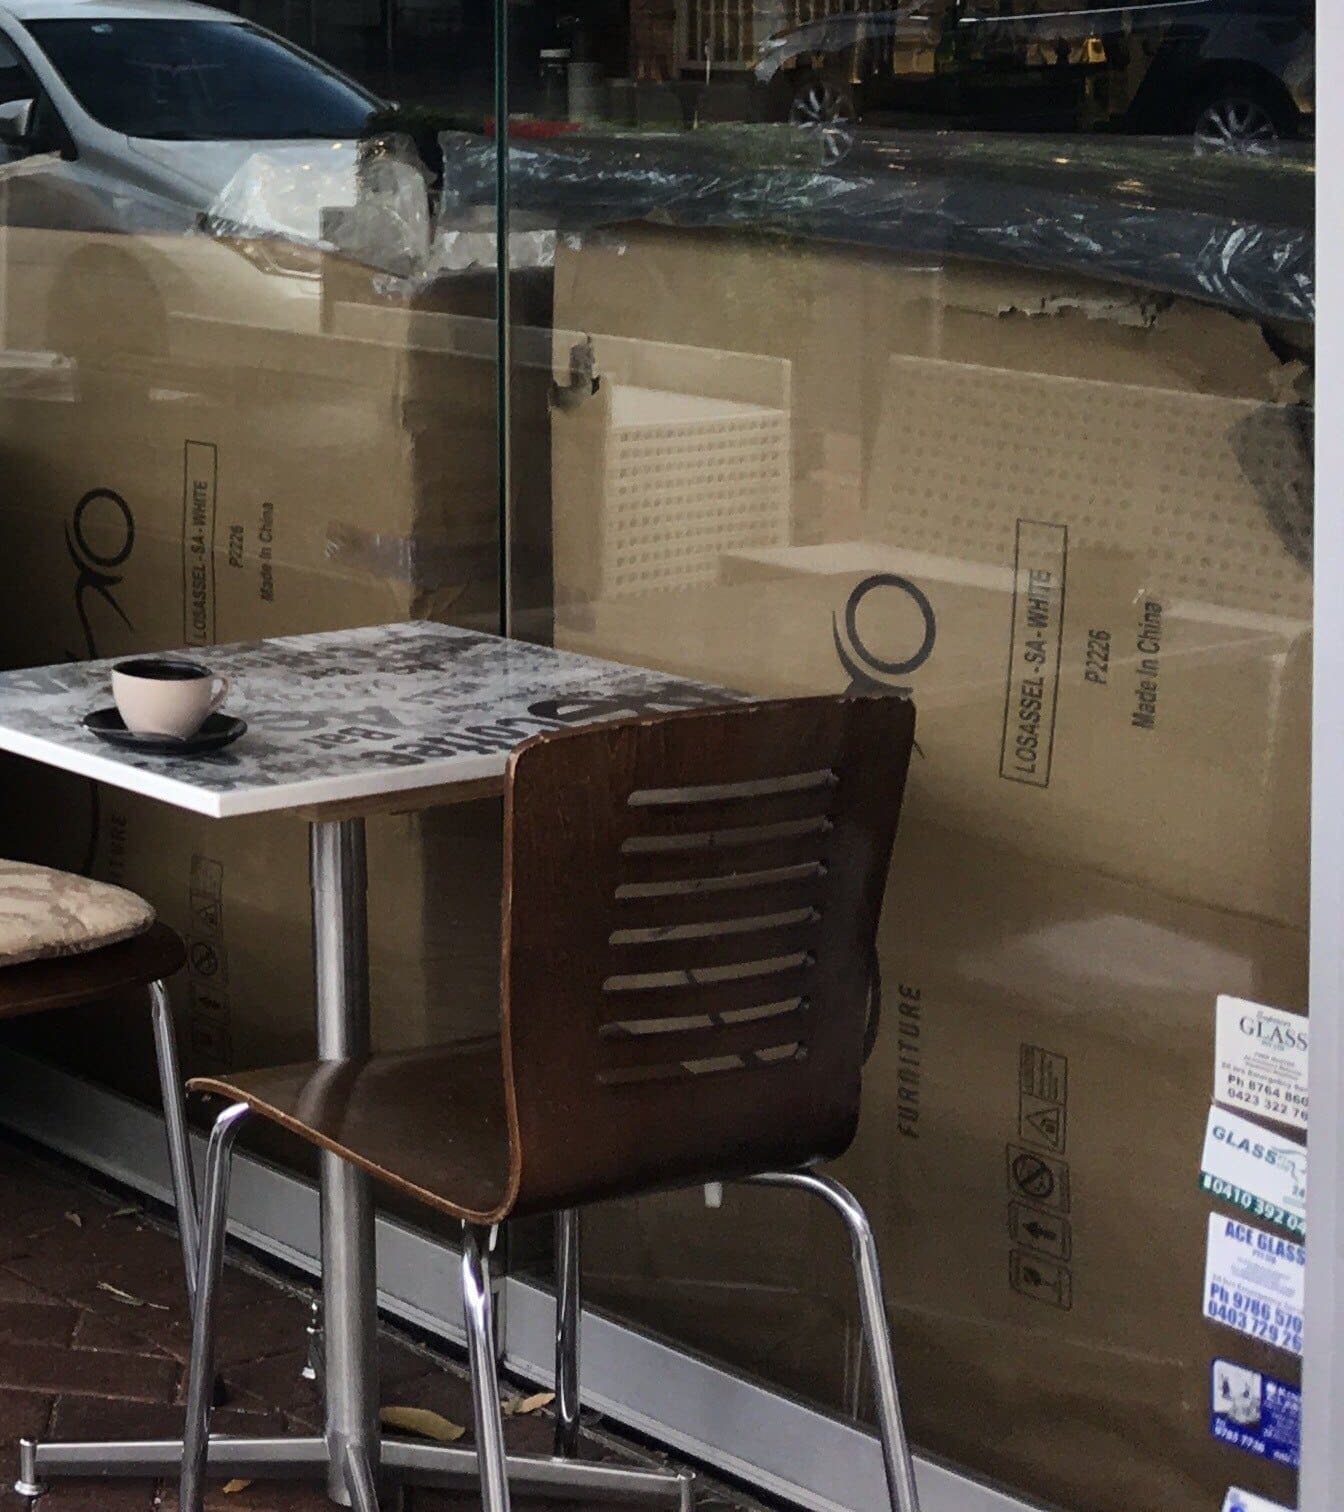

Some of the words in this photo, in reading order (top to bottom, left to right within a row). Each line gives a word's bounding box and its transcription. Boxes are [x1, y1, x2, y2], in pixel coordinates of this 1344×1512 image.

[1137, 600, 1163, 655] China
[1084, 628, 1112, 686] P2226
[1131, 680, 1158, 730] Made
[1239, 1015, 1308, 1052] GLASS
[897, 984, 921, 1139] FURNITURE
[1228, 1074, 1244, 1088] Ph
[1227, 1088, 1259, 1106] 0423
[1264, 1099, 1288, 1115] 322
[1212, 1125, 1278, 1165] GLASS
[1213, 1177, 1252, 1209] 0410
[1254, 1198, 1284, 1225] 392
[1225, 1220, 1253, 1245] ACE
[1257, 1232, 1306, 1266] GLASS
[1210, 1282, 1230, 1304] Ph
[1208, 1300, 1247, 1329] 0403
[1252, 1316, 1279, 1343] 729
